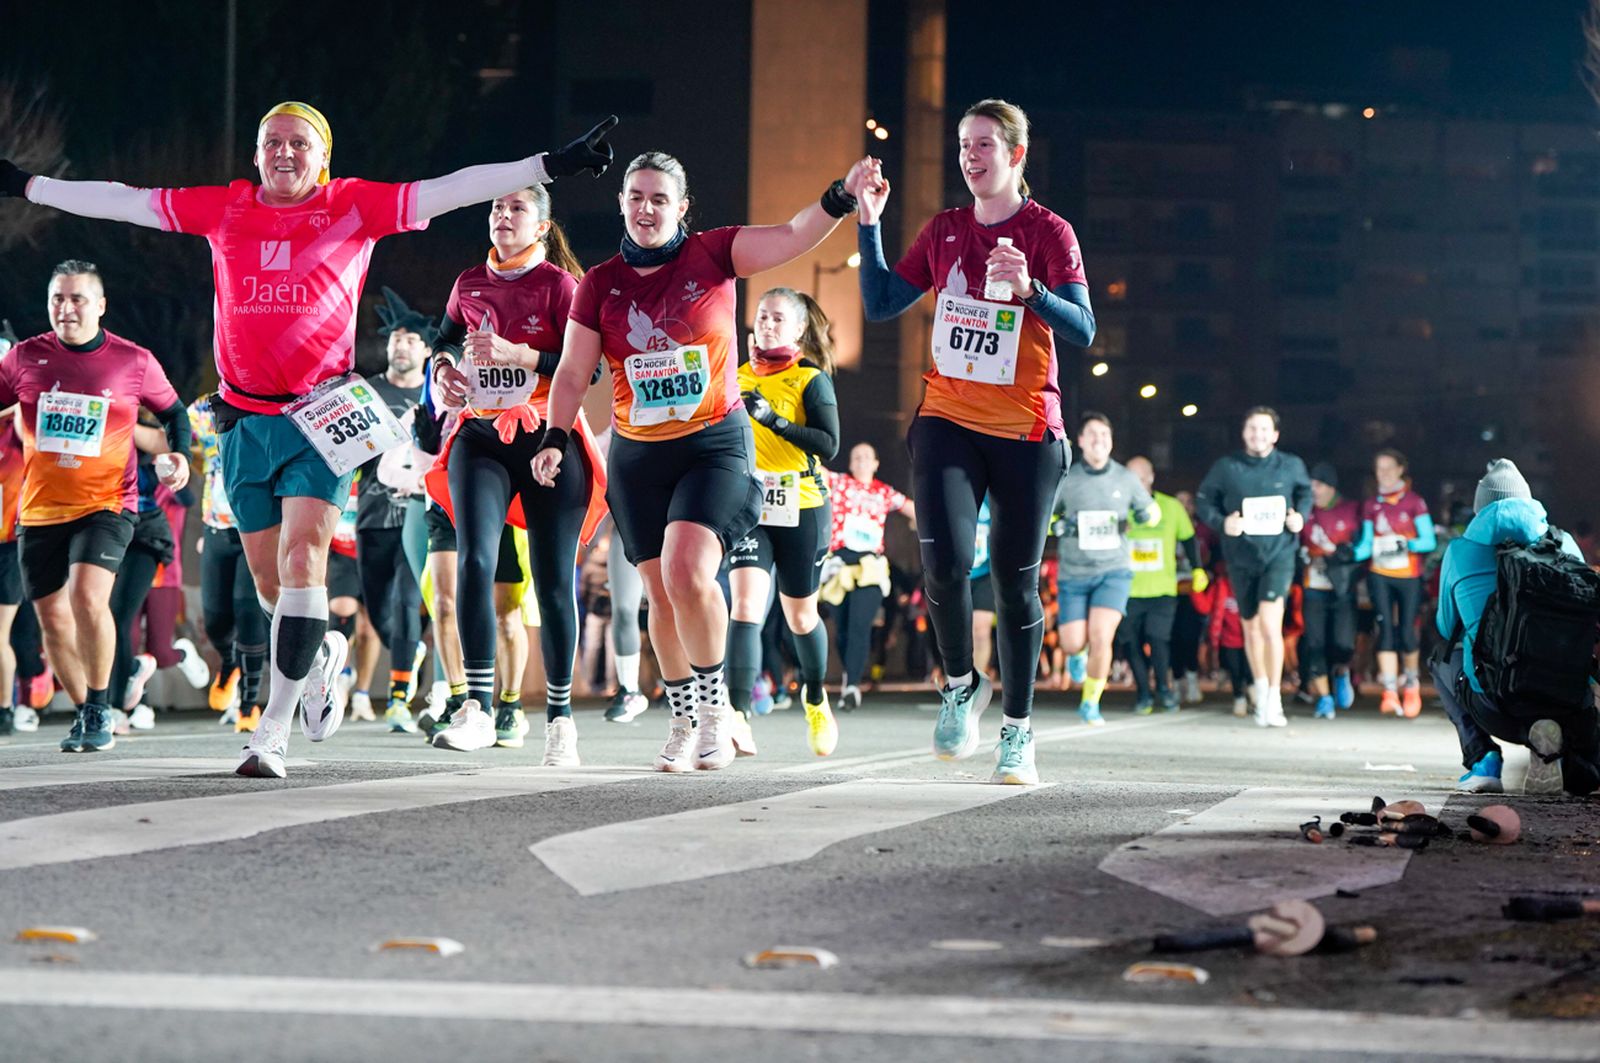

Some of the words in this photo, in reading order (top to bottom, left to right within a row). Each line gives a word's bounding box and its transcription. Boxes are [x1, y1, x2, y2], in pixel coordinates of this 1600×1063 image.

[242, 276, 307, 304] Jaén
[233, 303, 271, 315] PARAÍSO
[273, 304, 320, 316] INTERIOR
[944, 313, 959, 324] SAN
[955, 306, 977, 317] NOCHE
[979, 310, 989, 319] DE
[646, 336, 669, 351] 43
[949, 326, 999, 356] 6773
[644, 359, 667, 369] NOCHE
[669, 357, 677, 366] DE
[478, 367, 527, 389] 5090
[635, 370, 651, 380] SAN
[638, 371, 703, 402] 12838
[315, 399, 339, 418] NOCHE
[46, 413, 97, 436] 13682
[312, 416, 329, 431] SAN
[324, 405, 382, 446] 3334
[765, 488, 786, 506] 45
